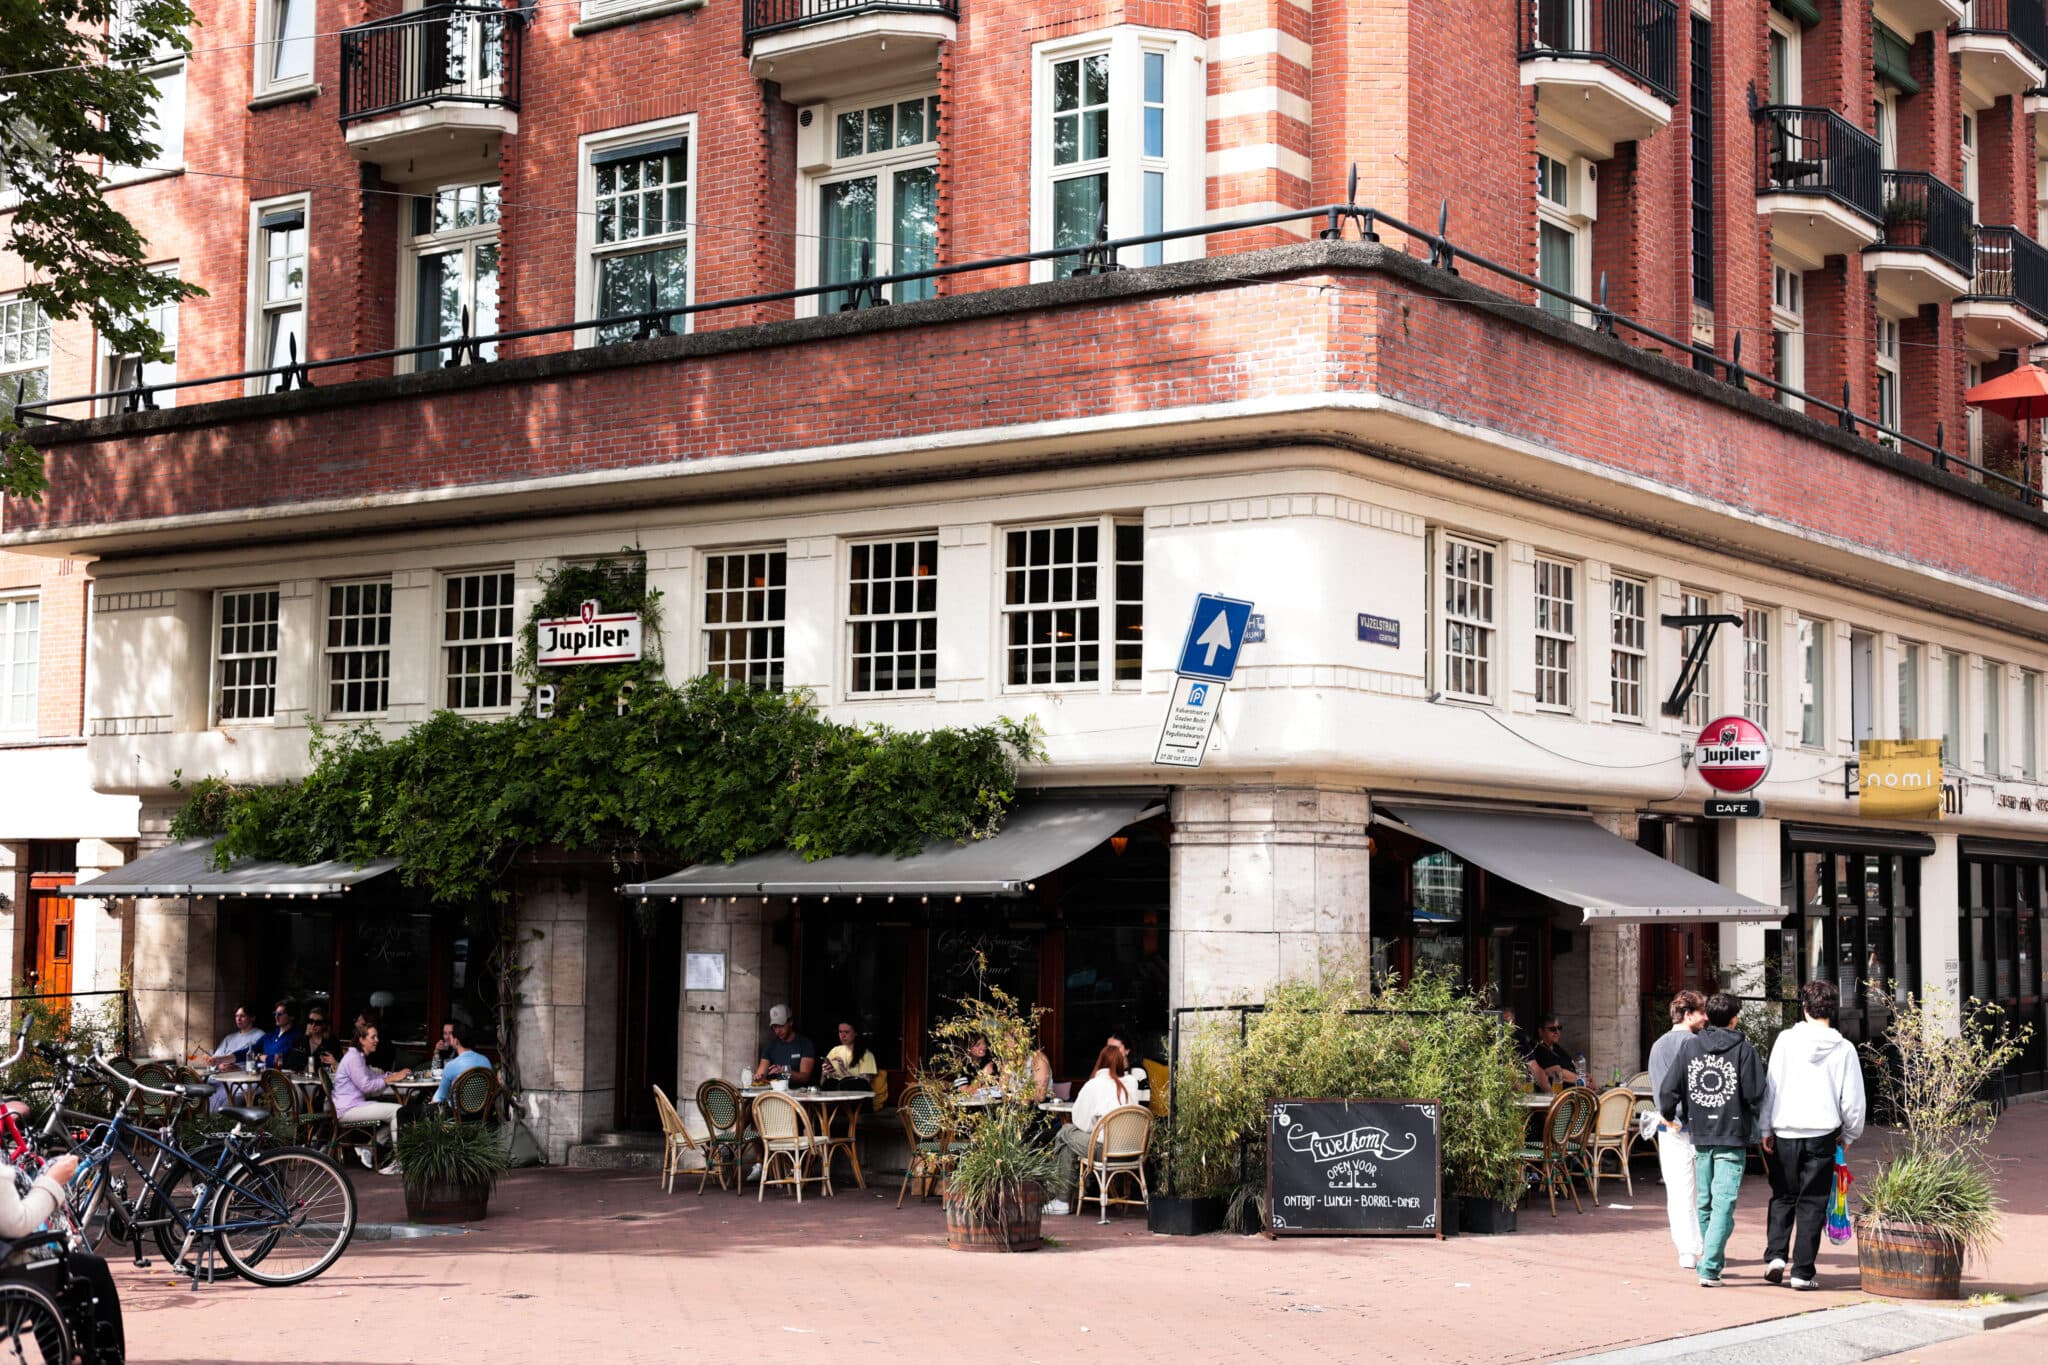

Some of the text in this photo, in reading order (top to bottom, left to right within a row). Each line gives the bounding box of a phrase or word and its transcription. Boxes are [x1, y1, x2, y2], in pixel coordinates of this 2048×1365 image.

[547, 624, 629, 655] Jupiler
[1702, 747, 1760, 764] Jupiler
[1867, 769, 1932, 787] nomi
[1716, 804, 1748, 813] CAFE
[1314, 1132, 1380, 1157] Welkom
[1327, 1160, 1378, 1179] OPEN VOOR
[1284, 1195, 1316, 1209] ONTBIJT
[1324, 1195, 1352, 1207] LUNCH
